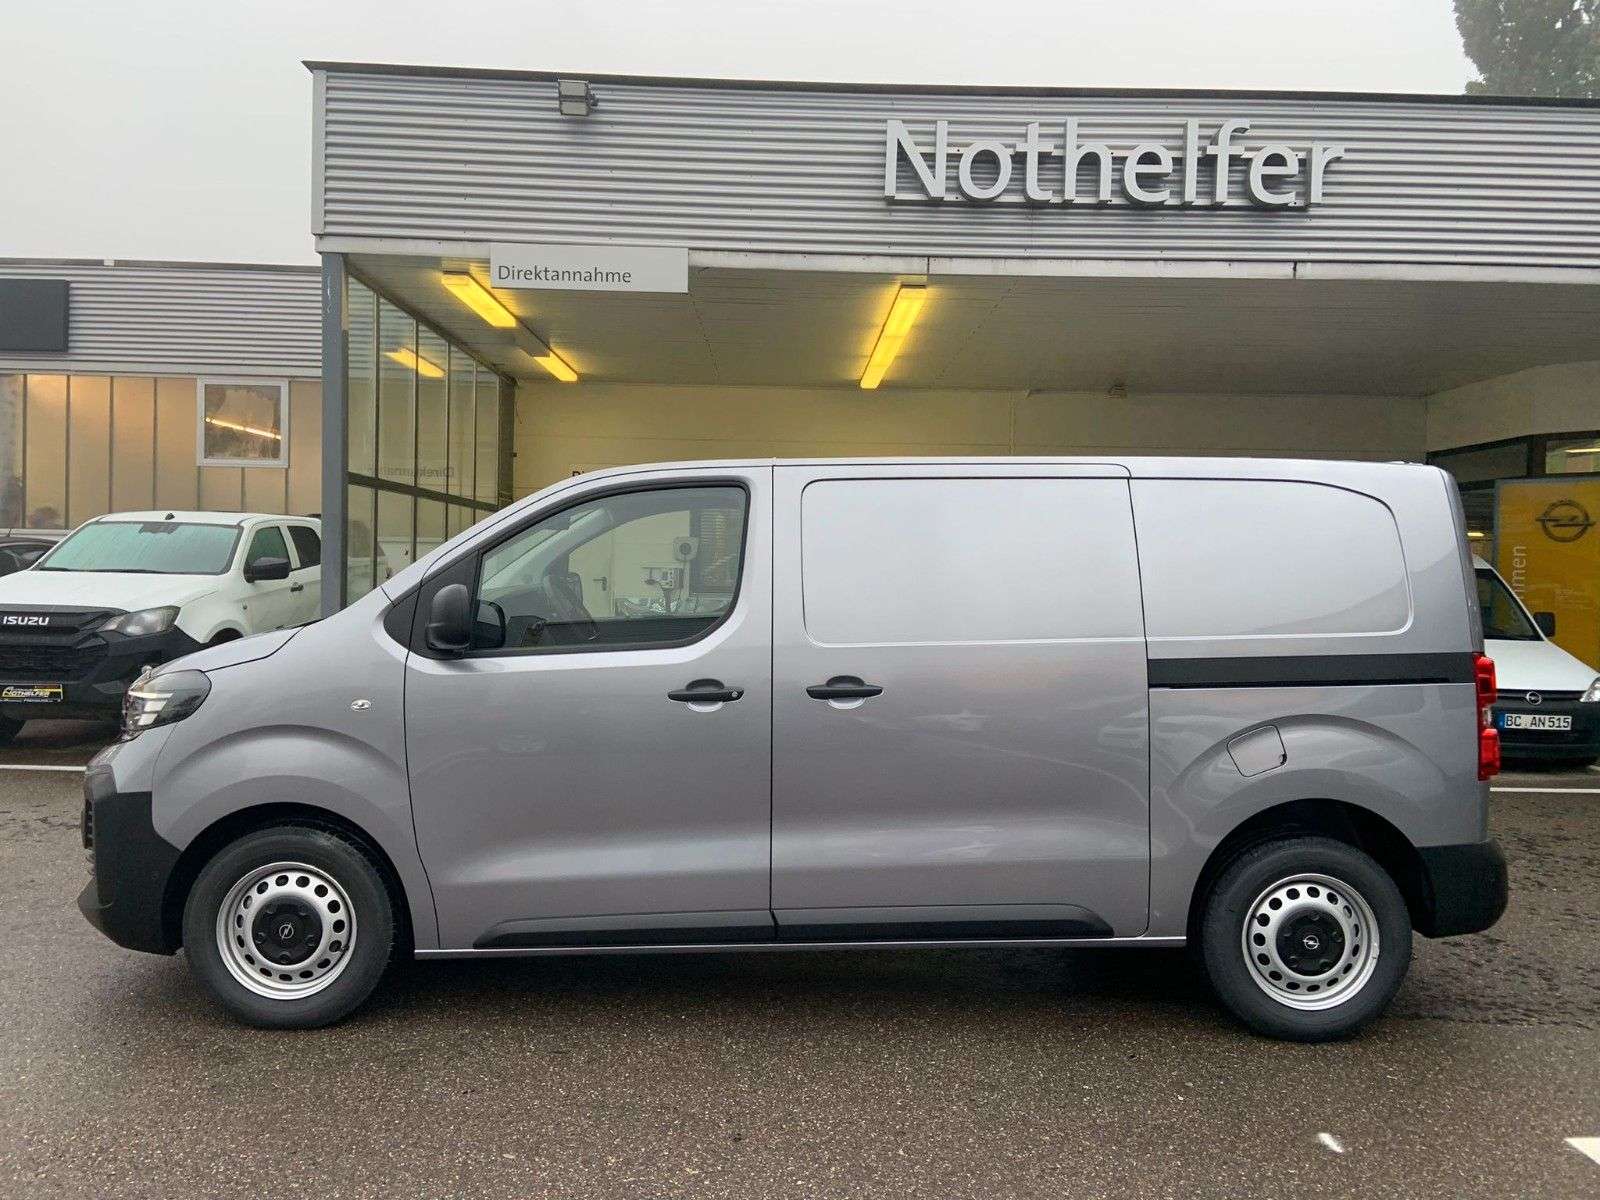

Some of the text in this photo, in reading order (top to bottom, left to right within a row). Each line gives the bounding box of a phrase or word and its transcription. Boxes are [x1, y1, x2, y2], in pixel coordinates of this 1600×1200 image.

[884, 117, 1346, 207] Nothelfer
[497, 265, 632, 284] Direktannahme
[2, 615, 50, 626] ISUZU
[1505, 715, 1571, 729] BC AN 515
